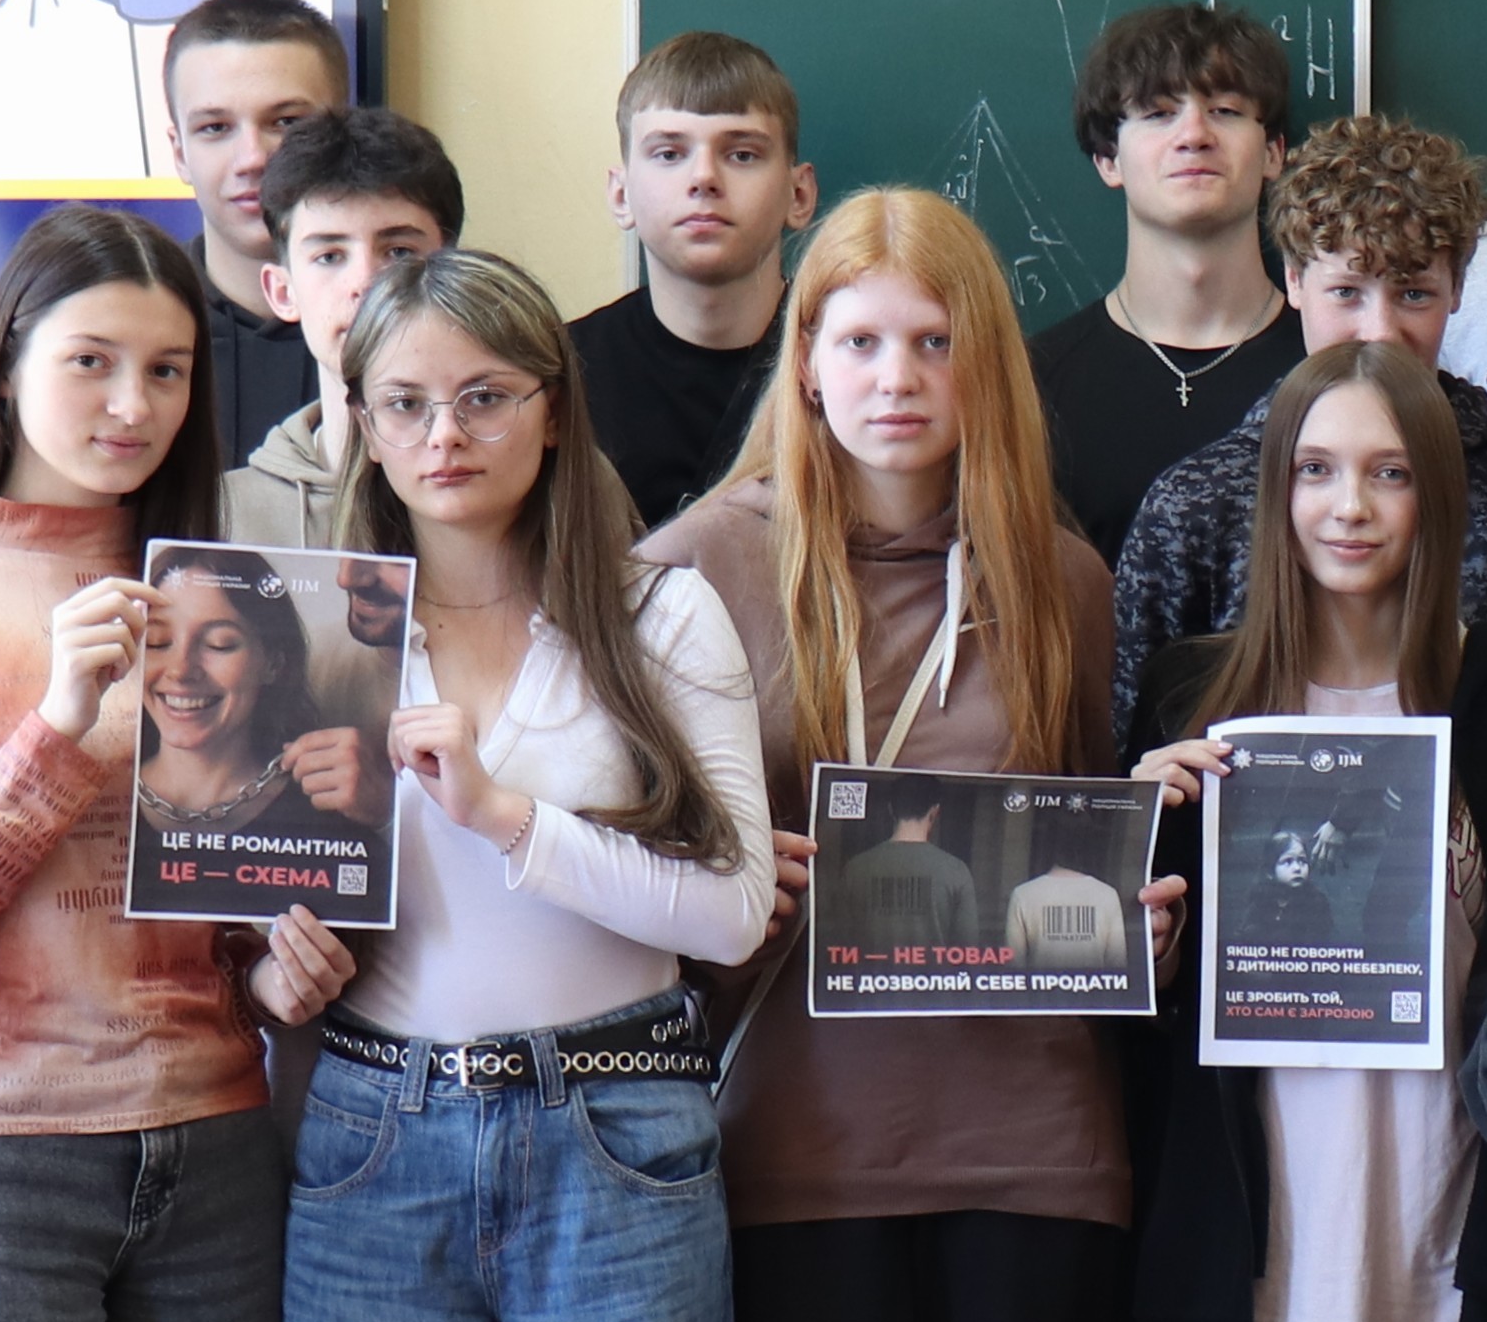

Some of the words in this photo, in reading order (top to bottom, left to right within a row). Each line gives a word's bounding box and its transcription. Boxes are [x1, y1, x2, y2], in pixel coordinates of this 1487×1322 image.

[291, 578, 321, 593] IJM
[1337, 754, 1364, 768] IJM
[1034, 794, 1062, 809] IJM
[161, 830, 192, 852] ЦЕ
[195, 833, 227, 853] НЕ
[230, 834, 369, 859] РОМАНТИКА
[159, 861, 198, 884] ЦЕ
[235, 863, 333, 890] СХЕМА
[826, 946, 860, 965] ТИ
[893, 946, 927, 965] НЕ
[931, 946, 1015, 966] ТОВАР
[1225, 945, 1269, 961] ЯКЩО
[1271, 946, 1290, 959] НЕ
[1292, 946, 1365, 960] ГОВОРИТИ
[1237, 960, 1310, 975] ДИТИНОЮ
[1311, 961, 1341, 975] ПРО
[1343, 961, 1425, 977] НЕБЕЗПЕКУ,
[826, 975, 855, 992] НЕ
[858, 971, 973, 995] ДОЗВОЛЯЙ
[975, 974, 1028, 992] СЕБЕ
[1031, 973, 1129, 994] ПРОДАТИ
[1225, 991, 1245, 1005] ЦЕ
[1247, 991, 1310, 1005] ЗРОБИТЬ
[1311, 989, 1345, 1007] ТОЙ,
[1224, 1006, 1253, 1019] ХТО
[1254, 1006, 1286, 1019] САМ
[1300, 1007, 1375, 1021] ЗАГРОЗОЮ
